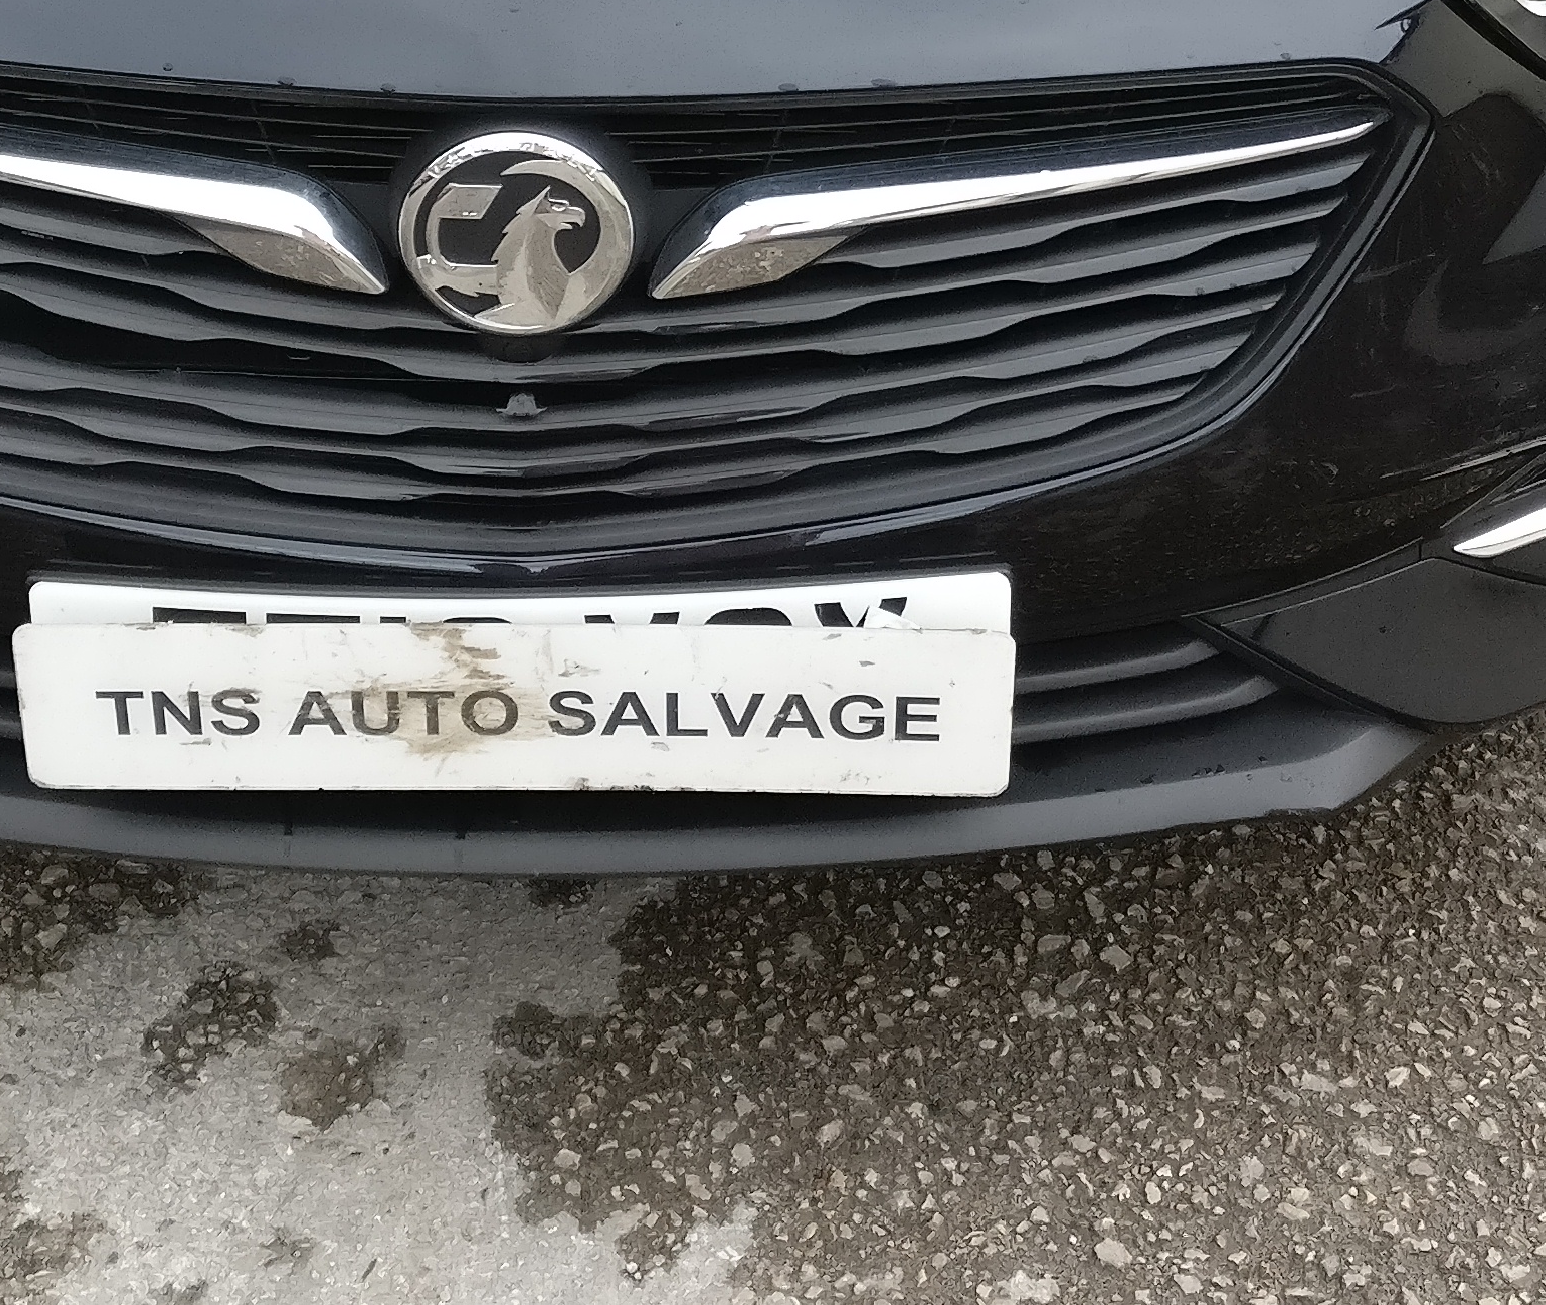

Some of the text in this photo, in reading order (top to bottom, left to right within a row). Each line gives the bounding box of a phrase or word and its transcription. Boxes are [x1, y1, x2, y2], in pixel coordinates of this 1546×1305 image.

[96, 689, 941, 742] TNS AUTO SALVAGE
